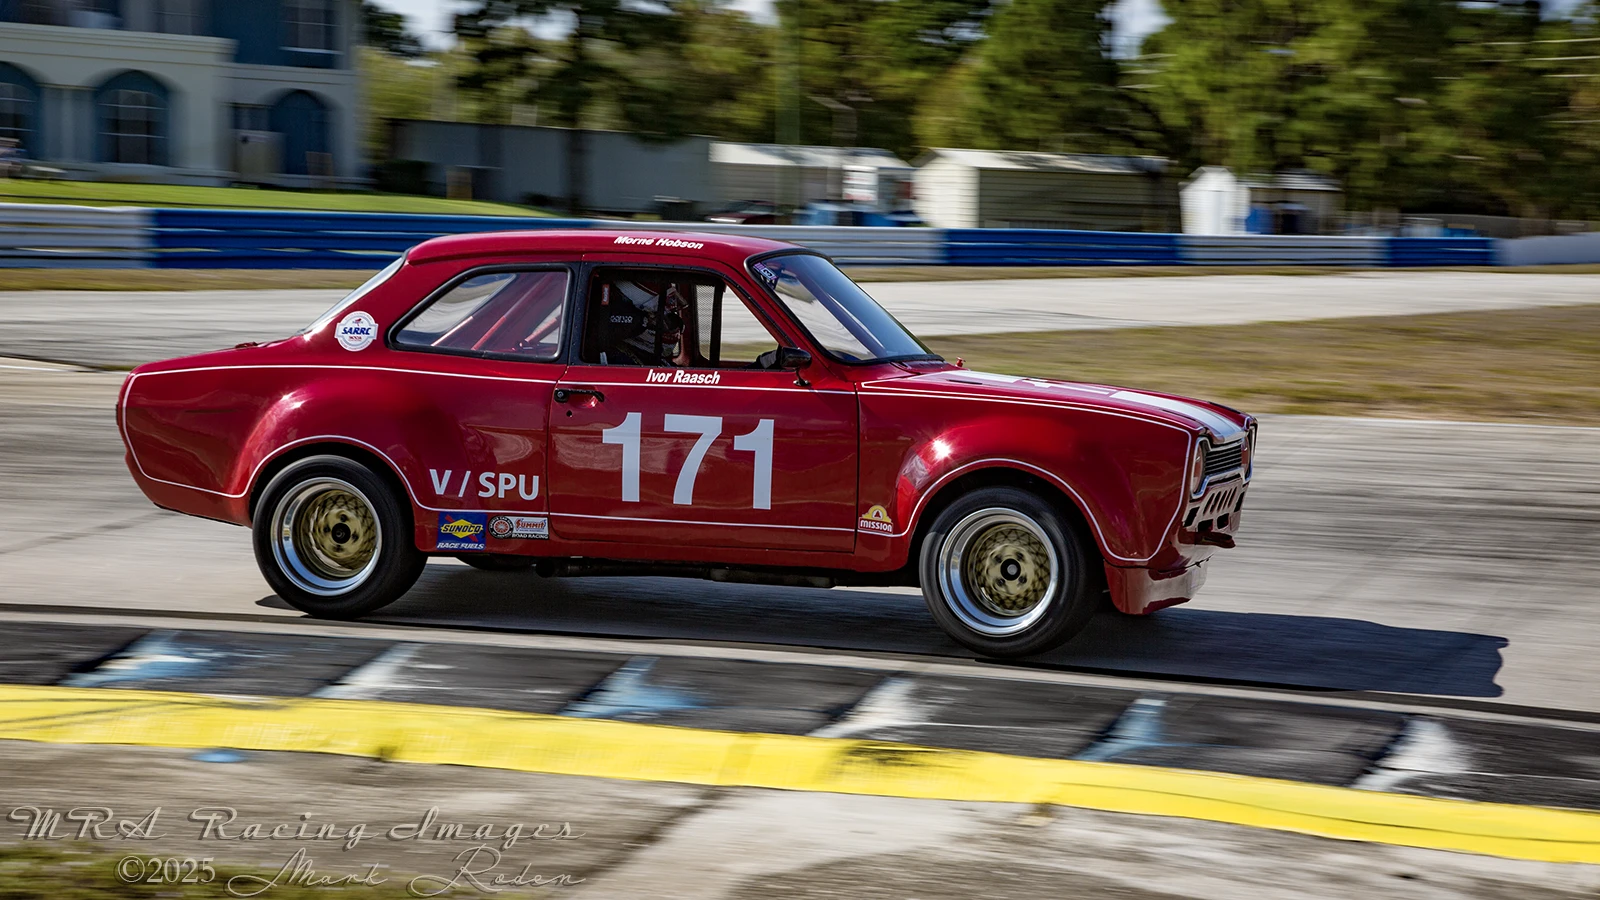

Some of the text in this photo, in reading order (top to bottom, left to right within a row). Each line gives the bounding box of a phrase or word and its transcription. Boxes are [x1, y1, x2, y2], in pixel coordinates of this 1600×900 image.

[655, 238, 704, 250] Hobson
[342, 326, 371, 335] SARRC
[646, 369, 720, 385] Ivor Raasch
[602, 412, 774, 510] 171
[429, 469, 452, 495] V
[478, 471, 539, 500] SPU
[442, 524, 482, 533] SUNOCO
